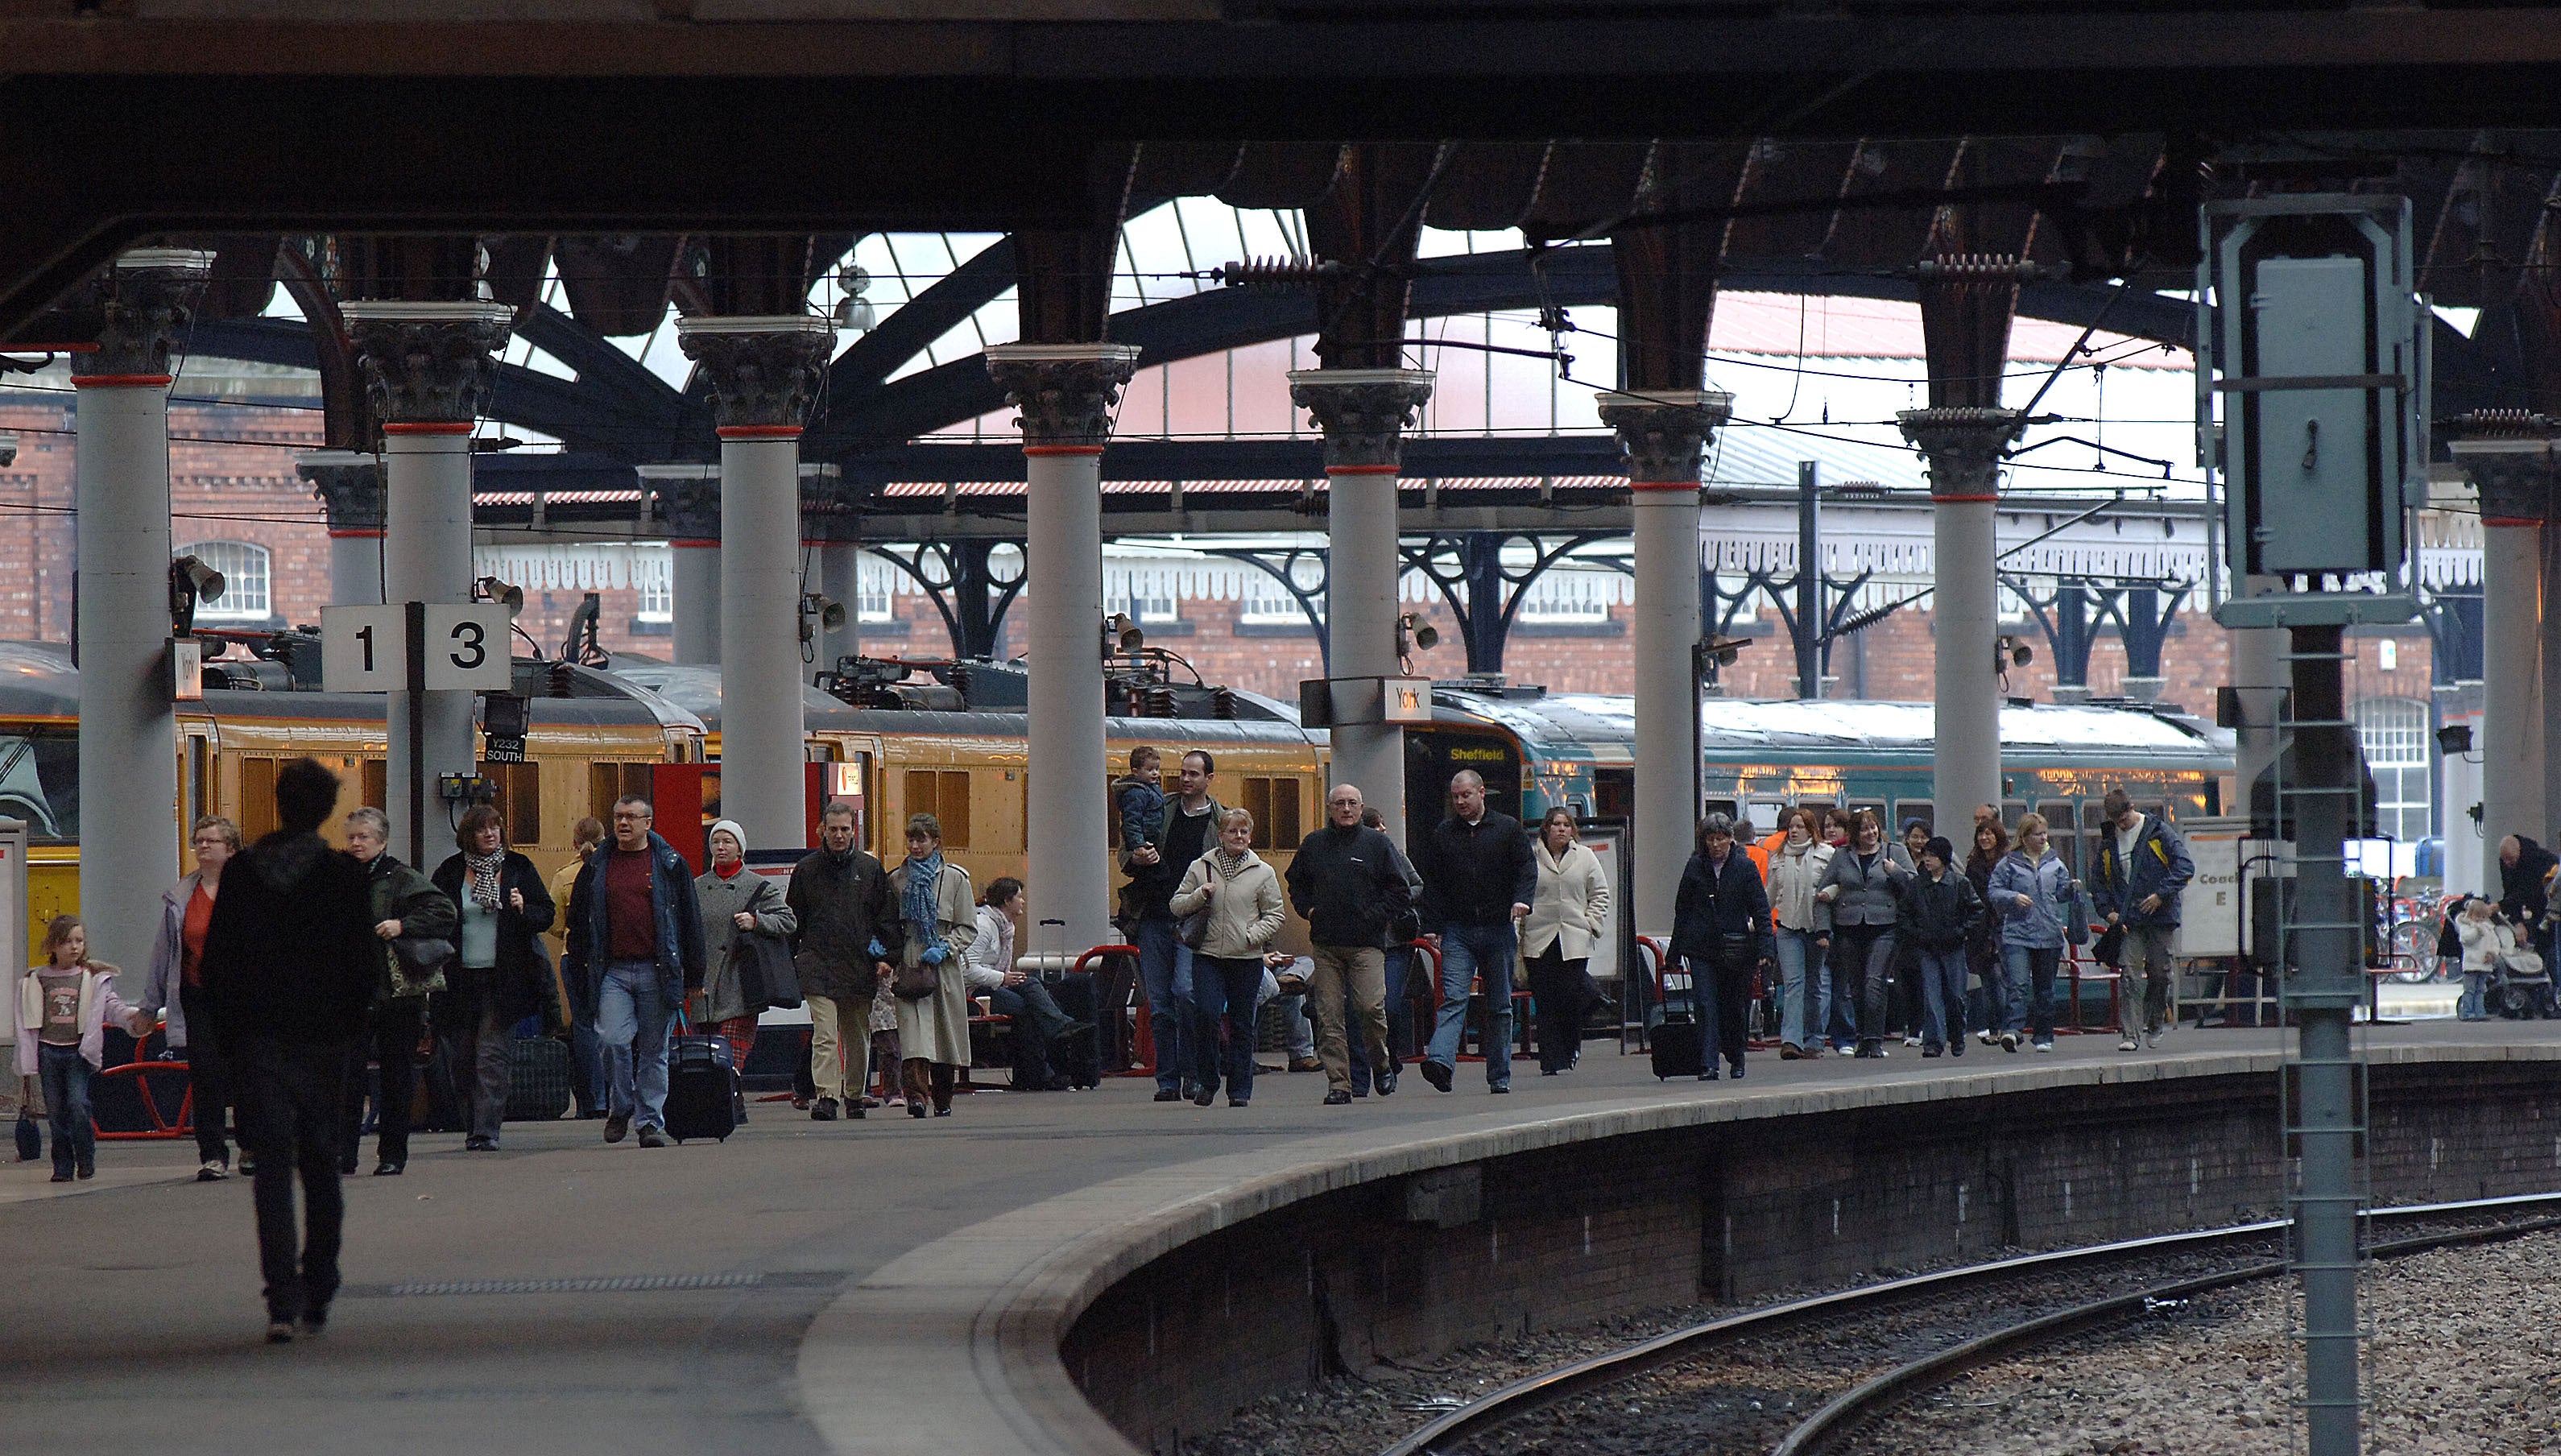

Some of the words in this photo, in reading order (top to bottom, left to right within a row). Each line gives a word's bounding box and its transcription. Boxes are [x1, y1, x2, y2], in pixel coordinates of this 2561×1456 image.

[355, 625, 374, 672] 1
[449, 621, 486, 669] 3
[1396, 687, 1420, 709] York
[493, 738, 519, 750] Y232
[486, 750, 522, 762] SOUTH
[1450, 748, 1504, 760] Sheffield
[2216, 891, 2227, 906] E
